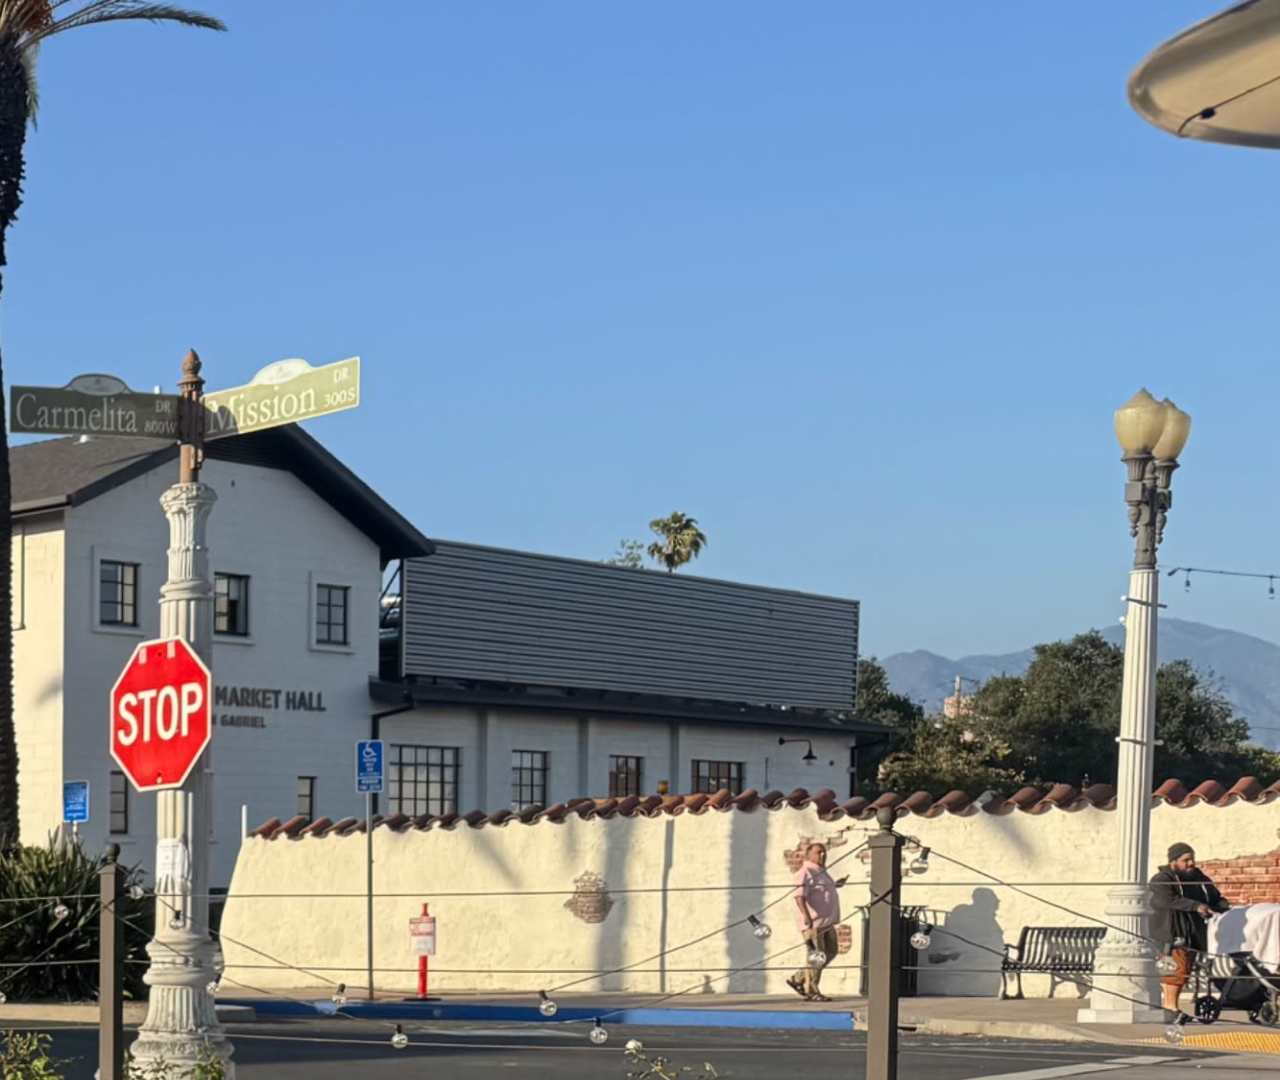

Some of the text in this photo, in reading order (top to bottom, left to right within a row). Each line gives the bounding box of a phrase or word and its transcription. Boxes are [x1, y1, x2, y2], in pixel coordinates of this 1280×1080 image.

[333, 367, 349, 383] DR
[155, 399, 171, 413] DR
[206, 385, 317, 433] Mission
[324, 387, 355, 407] 300S
[16, 393, 138, 433] Carmelita
[215, 686, 327, 712] MARKET HALL
[117, 682, 203, 746] STOP
